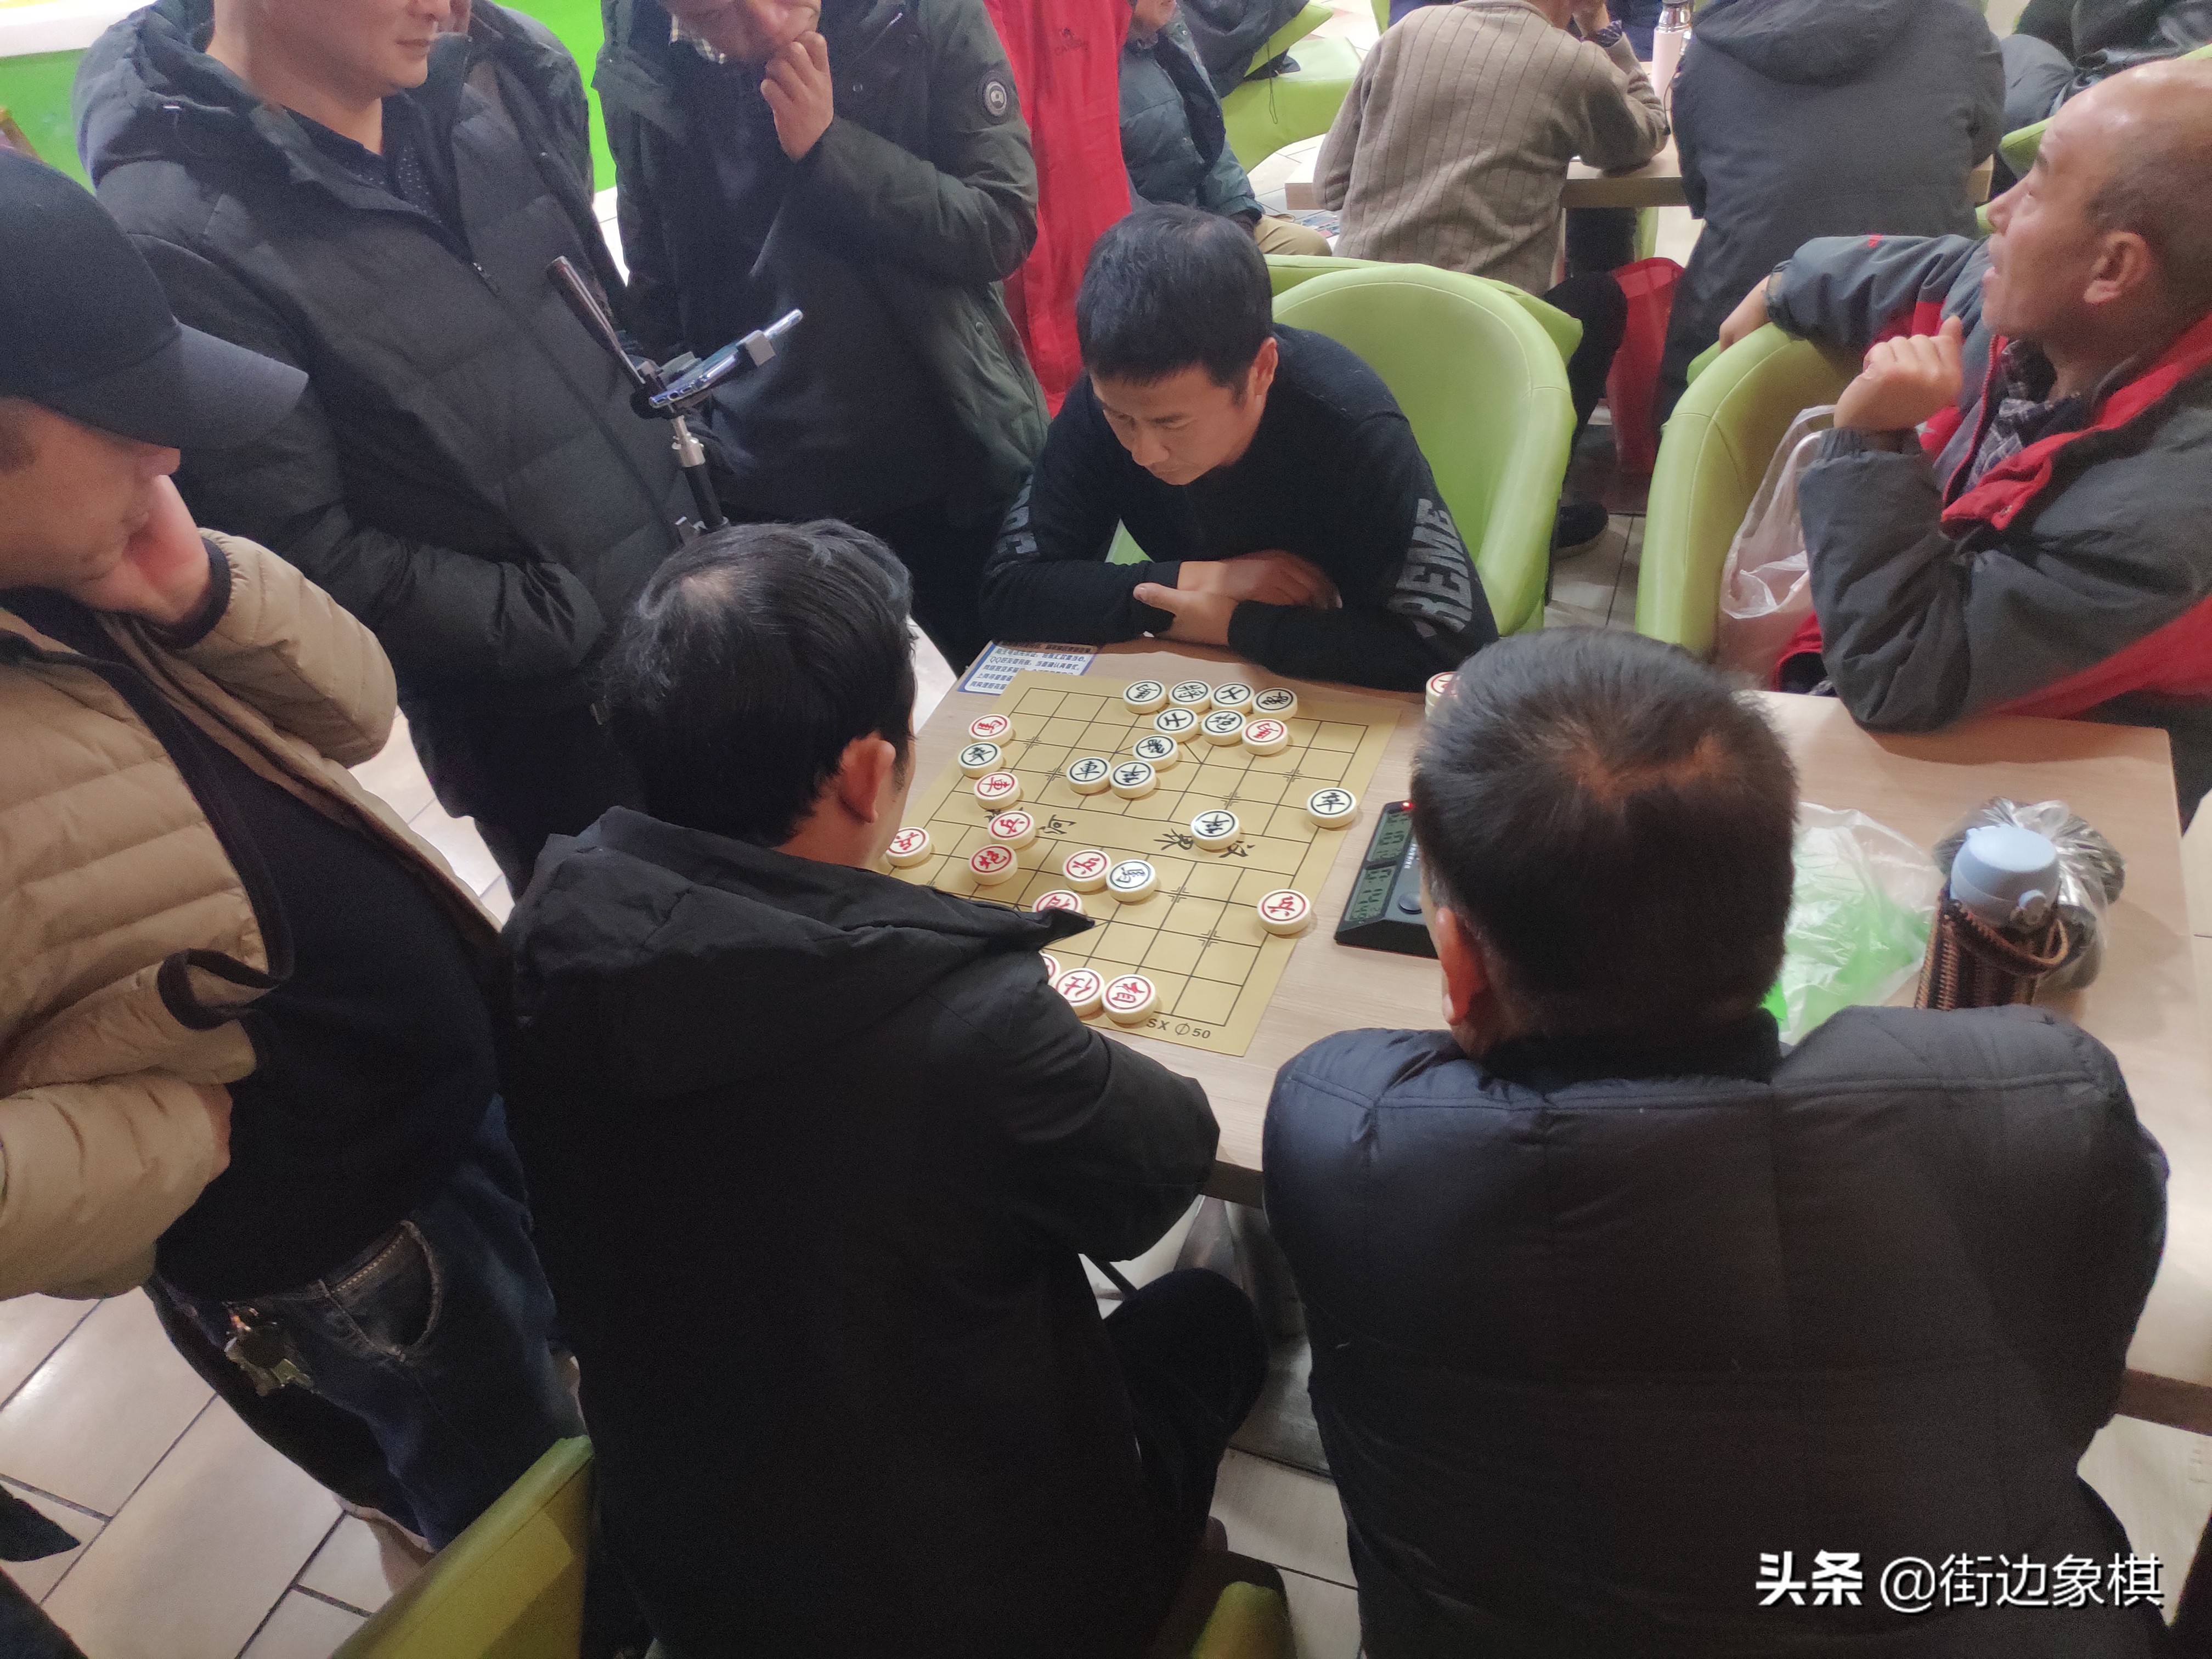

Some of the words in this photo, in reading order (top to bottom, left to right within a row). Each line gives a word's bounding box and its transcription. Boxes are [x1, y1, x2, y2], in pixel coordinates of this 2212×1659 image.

[1317, 793, 1345, 811] 卒
[1268, 896, 1295, 916] 兵
[1146, 1018, 1170, 1031] SX
